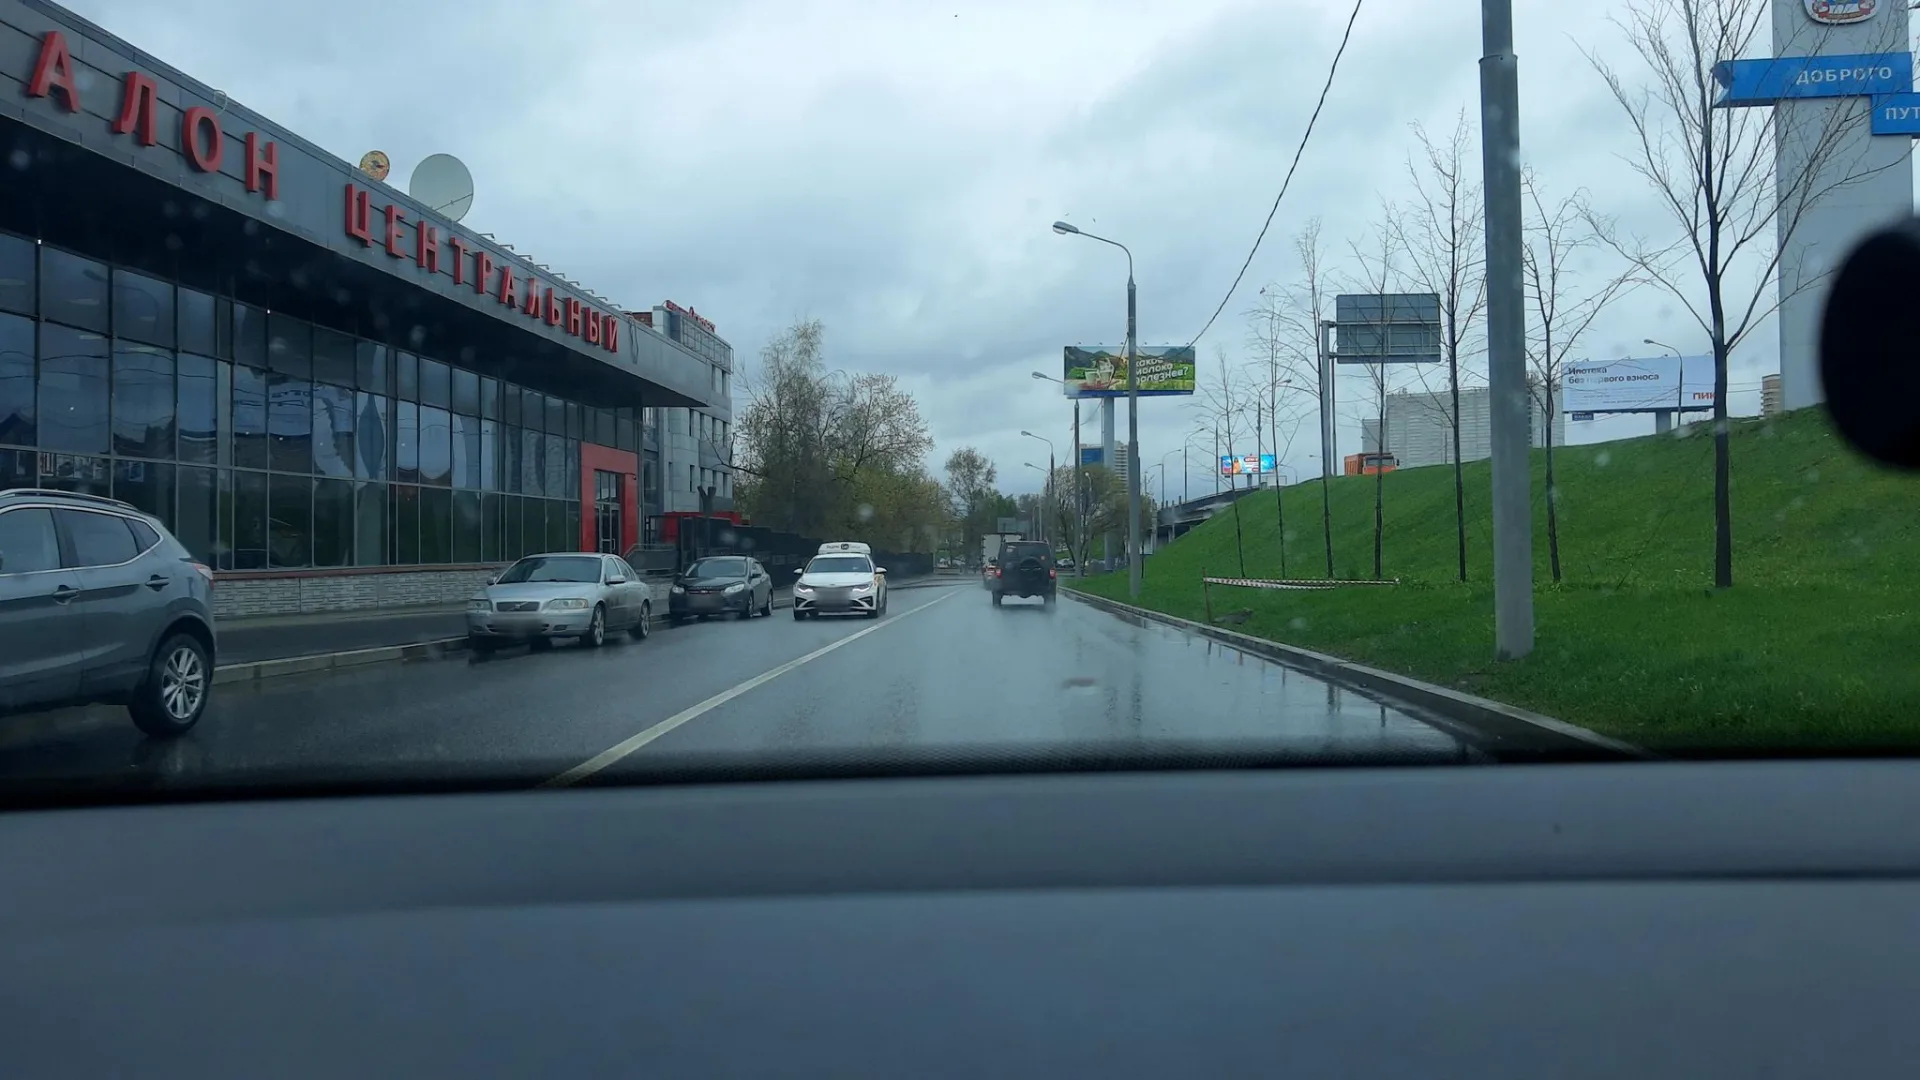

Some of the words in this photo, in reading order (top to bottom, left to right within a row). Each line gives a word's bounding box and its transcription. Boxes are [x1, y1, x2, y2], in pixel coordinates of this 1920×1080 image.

[1796, 66, 1892, 86] ДОБРОГО
[28, 31, 278, 200] АЛОН
[345, 183, 619, 353] ЦЕНТРАЛЬНЫЙ
[1568, 367, 1607, 375] Ипотека
[1568, 376, 1585, 384] без
[1627, 374, 1660, 382] взноса
